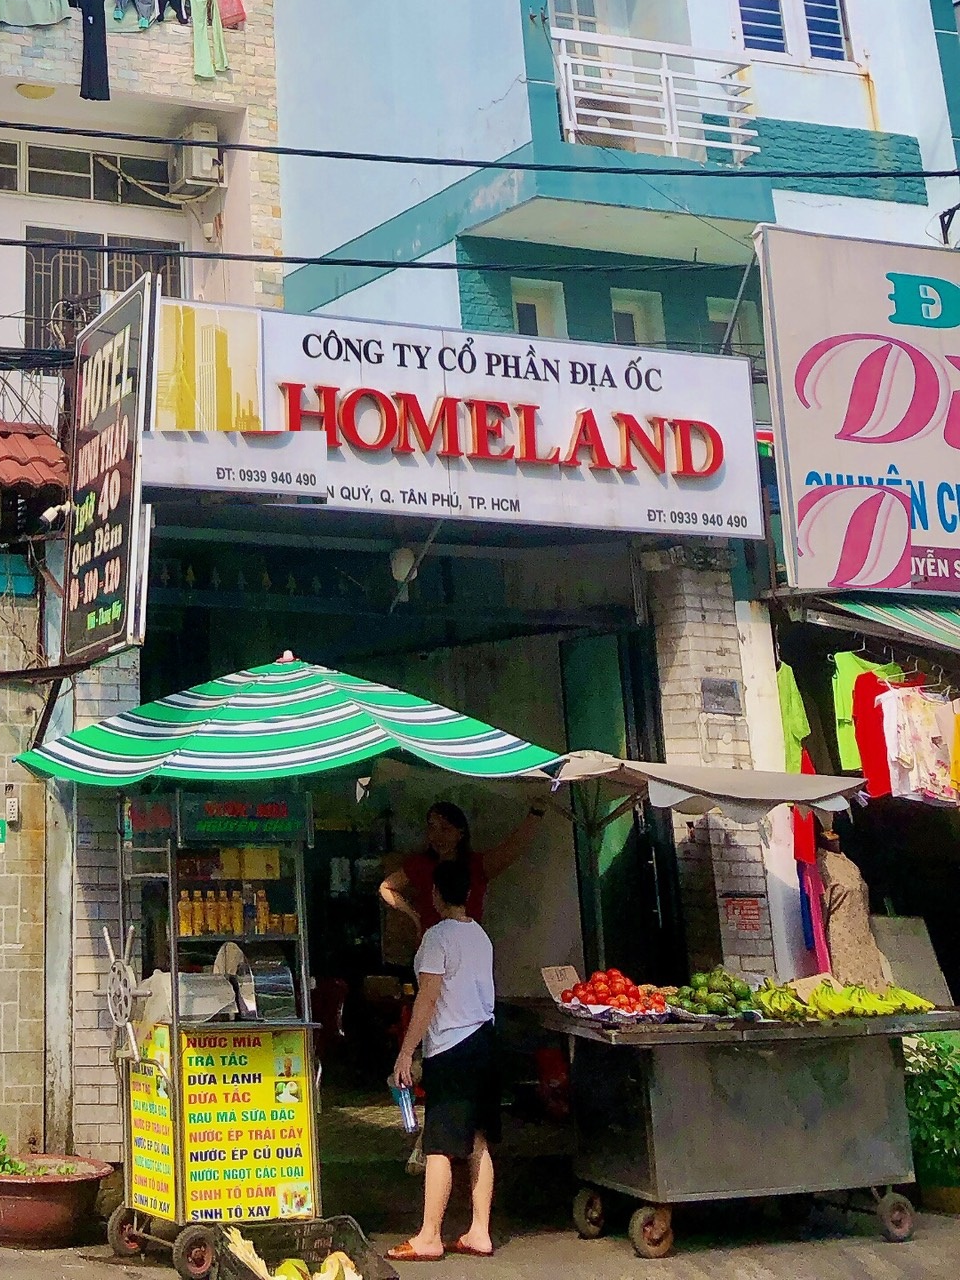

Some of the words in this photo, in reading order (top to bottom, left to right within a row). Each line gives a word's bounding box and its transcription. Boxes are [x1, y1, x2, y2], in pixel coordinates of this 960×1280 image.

[302, 329, 384, 365] CÔNG
[392, 342, 431, 370] TY
[438, 336, 477, 374] CỔ
[485, 344, 561, 383] PHẦN
[569, 360, 618, 392] ĐỊA
[624, 356, 663, 392] ỐC
[80, 323, 133, 431] HOTEL
[279, 381, 725, 478] HOMELAND
[239, 468, 267, 483] 0939
[271, 471, 292, 485] 940
[295, 473, 317, 487] 490
[340, 484, 373, 504] QUÝ,
[380, 488, 395, 504] Q.
[399, 487, 428, 506] TÂN
[431, 490, 462, 510] PHÚ,
[468, 495, 487, 511] TP.
[491, 497, 521, 513] HCM
[647, 509, 667, 524] ĐT:
[670, 511, 698, 525] 0939
[702, 513, 723, 527] 940
[726, 514, 748, 529] 490
[189, 1111, 212, 1124] RAU
[231, 1147, 248, 1161] ÉP
[190, 1188, 222, 1202] SINH
[190, 1208, 222, 1221] SINH
[248, 1205, 271, 1218] XAY
